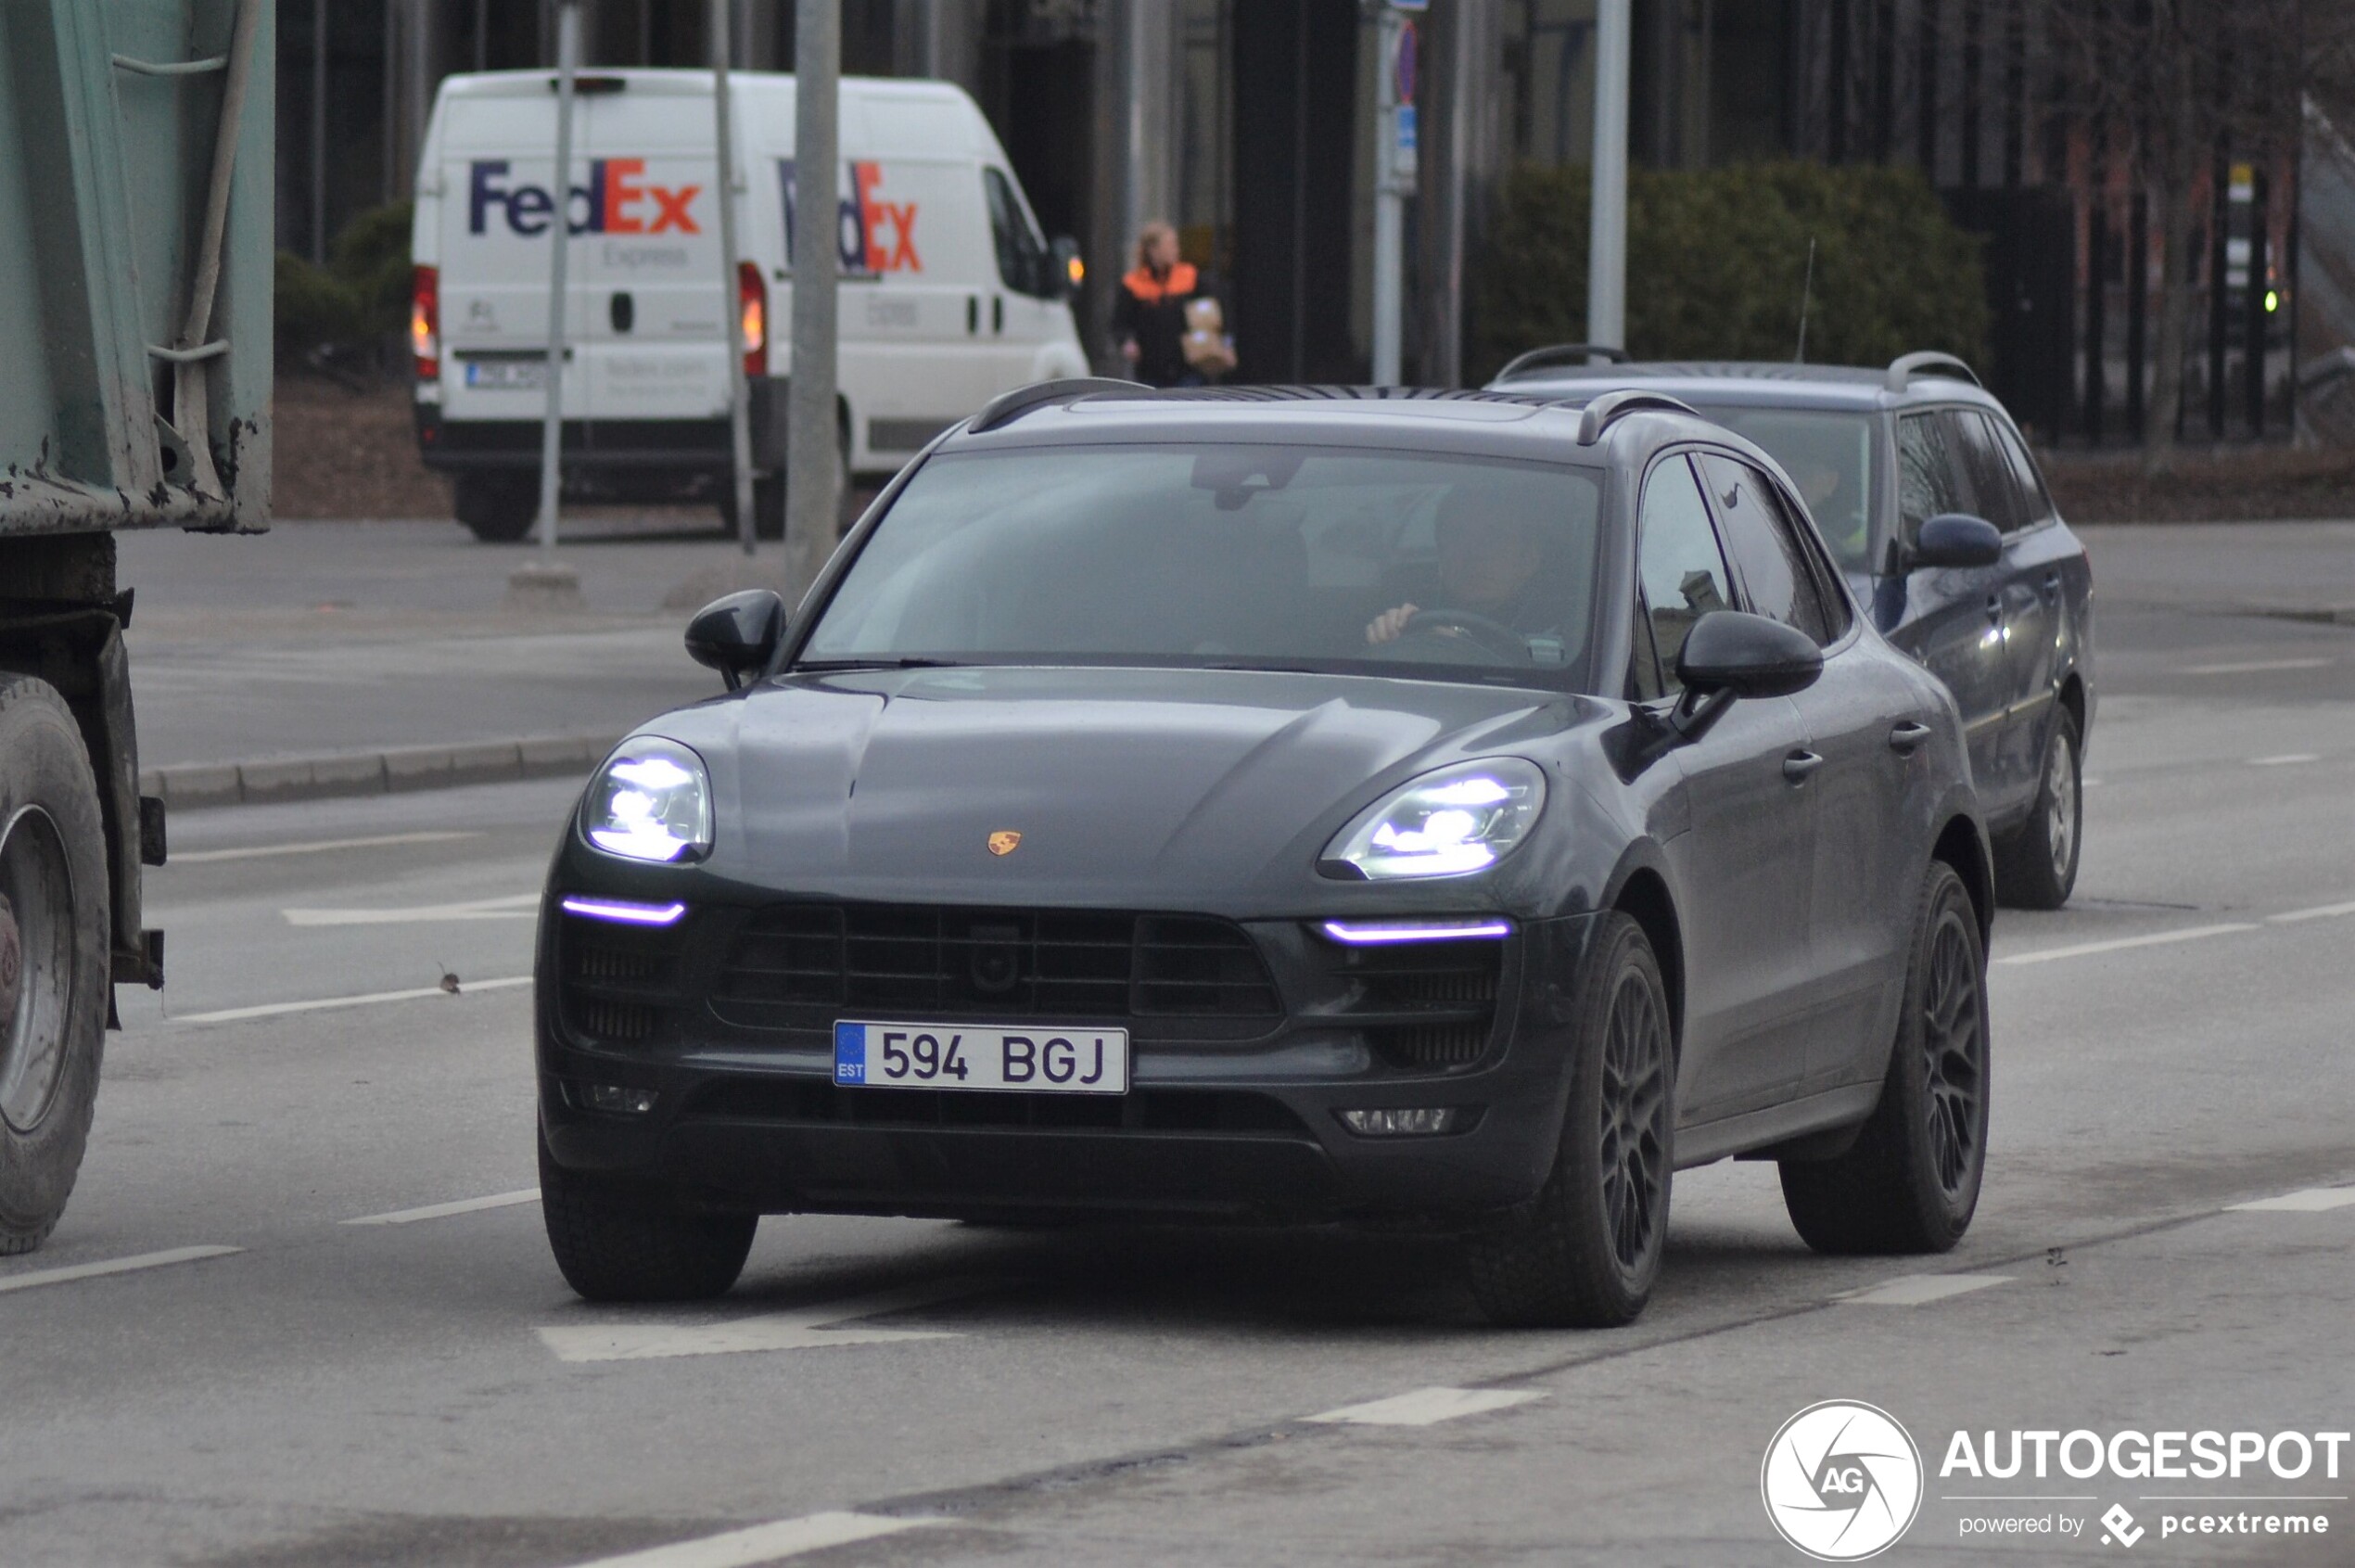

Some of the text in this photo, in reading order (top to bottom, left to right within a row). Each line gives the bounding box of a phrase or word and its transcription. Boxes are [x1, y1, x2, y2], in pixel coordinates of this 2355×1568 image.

[469, 159, 702, 236] FedEx
[838, 1064, 864, 1077] EST
[884, 1032, 1103, 1084] 594 BGJ
